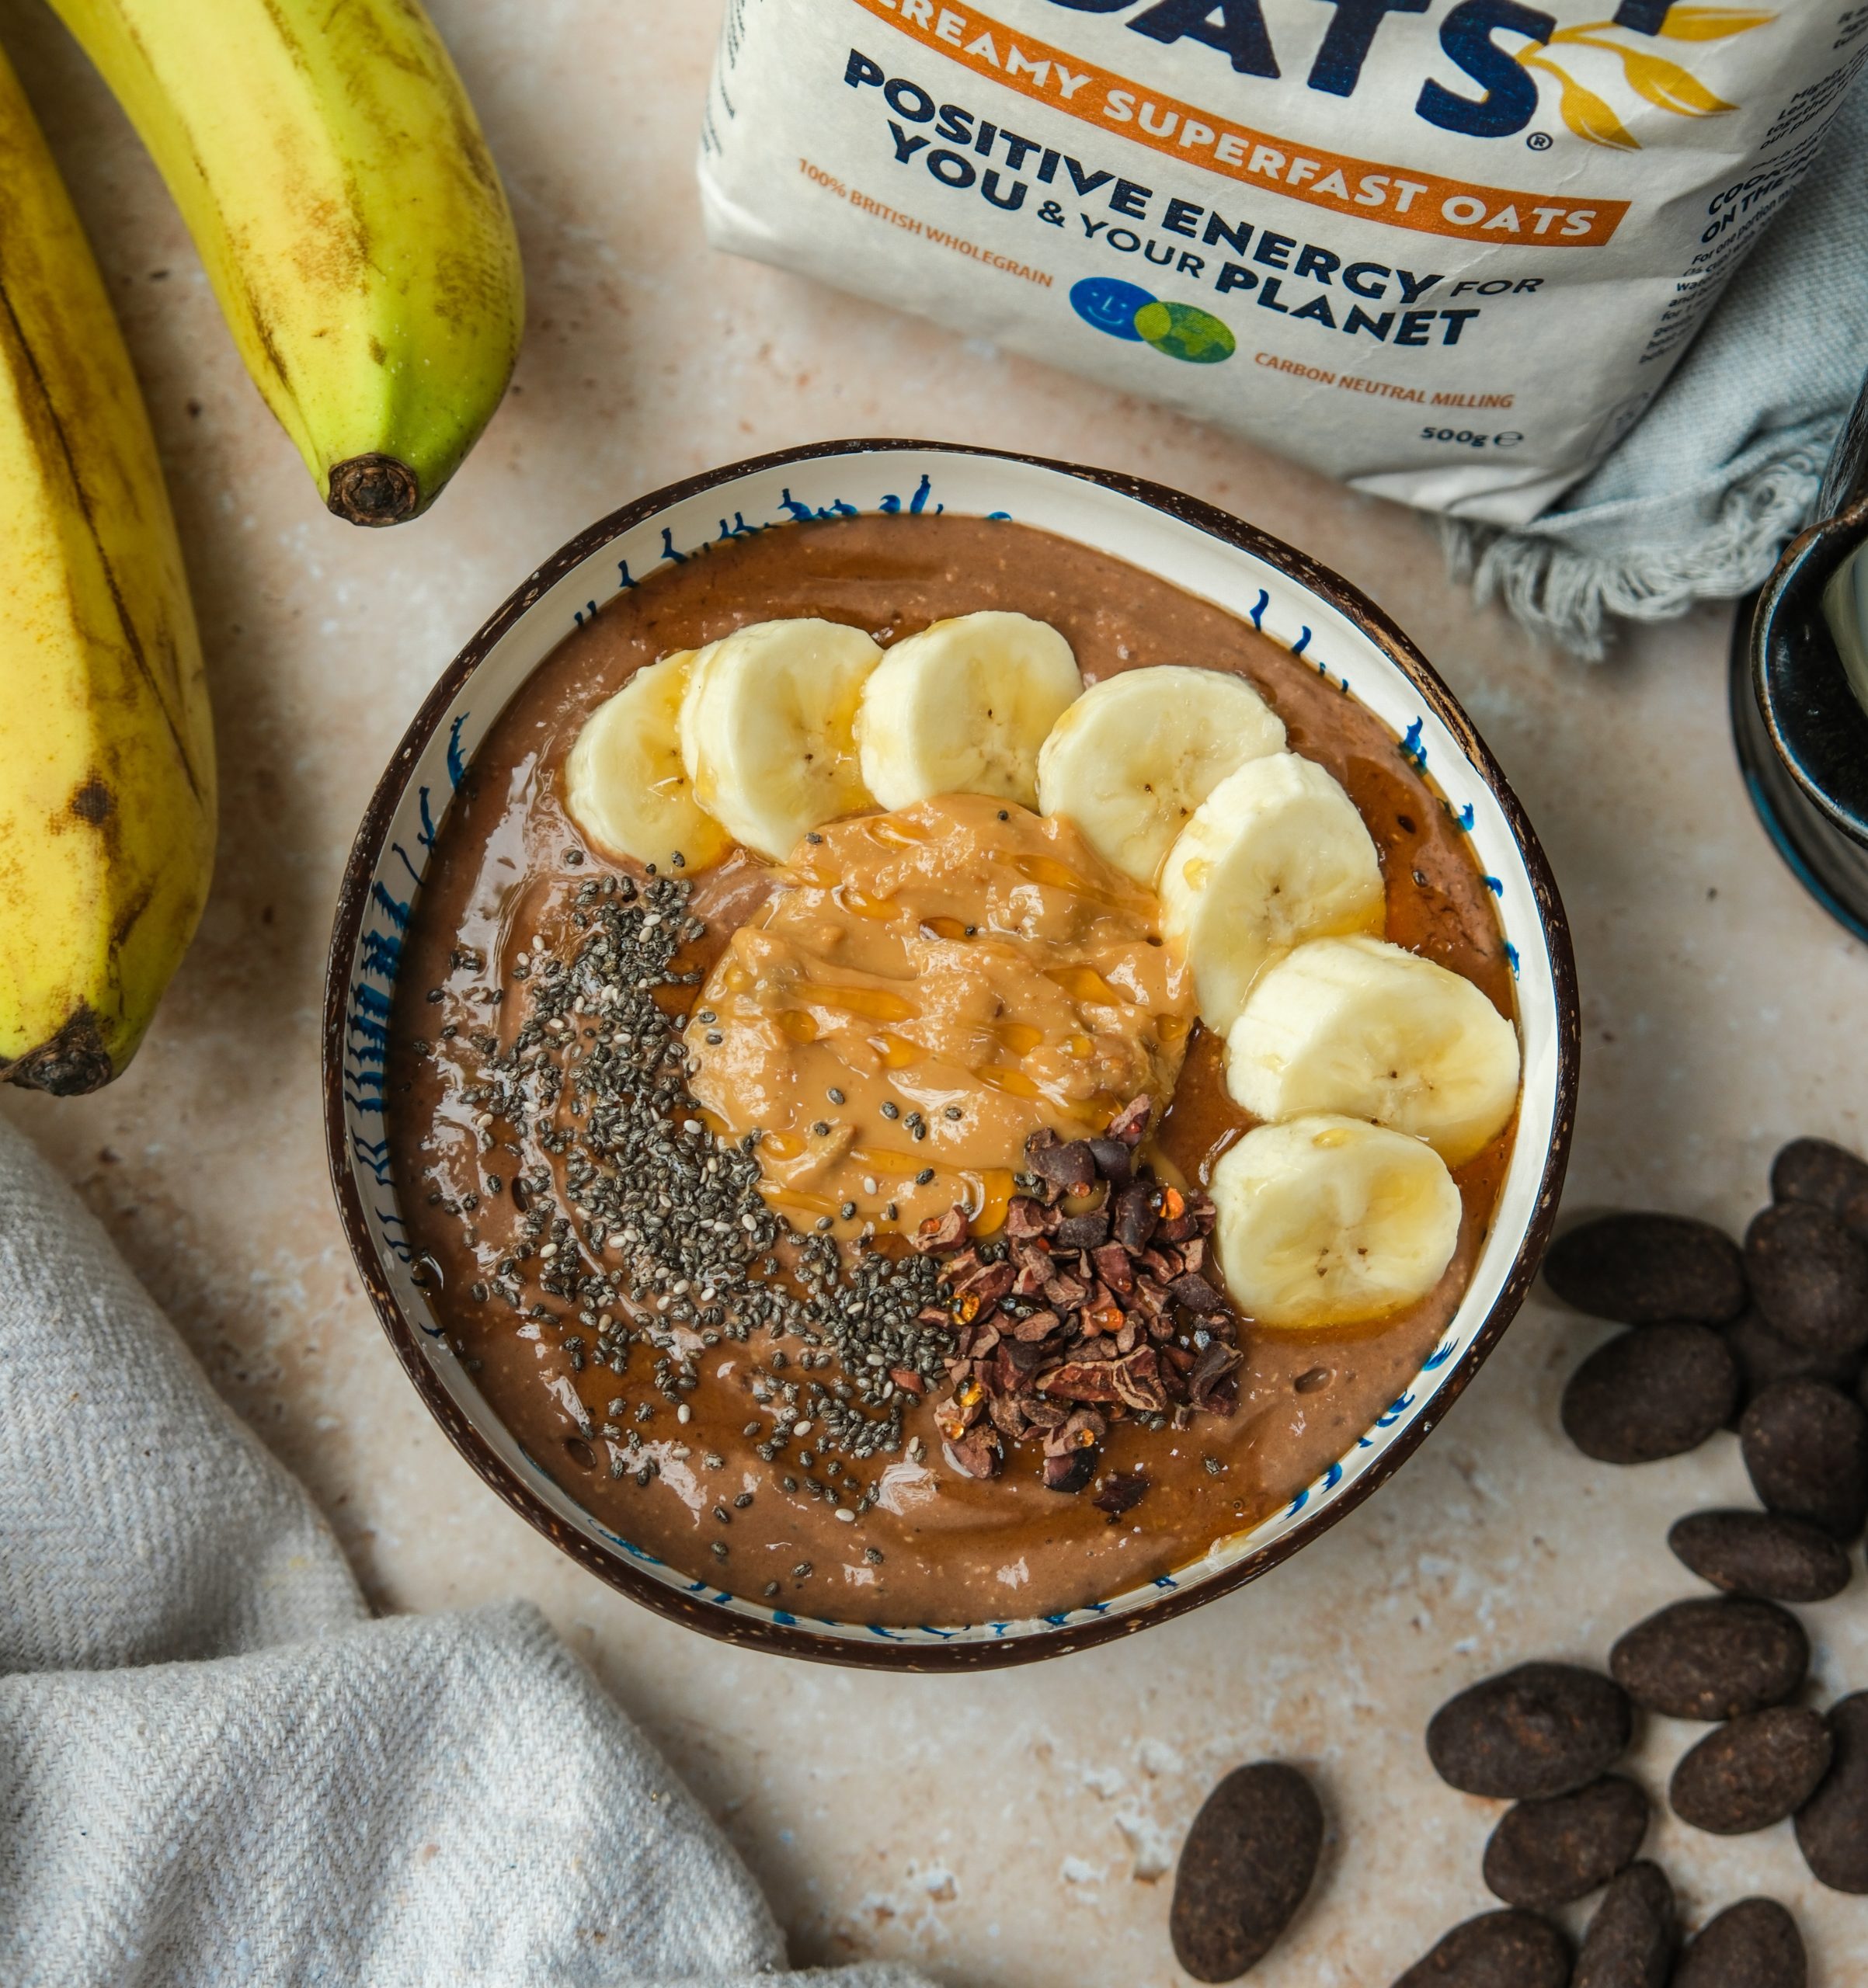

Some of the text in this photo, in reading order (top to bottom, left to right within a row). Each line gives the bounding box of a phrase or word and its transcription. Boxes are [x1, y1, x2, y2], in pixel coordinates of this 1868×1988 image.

[878, 0, 1597, 236] REAMY SUPERFAST OATS
[1045, 0, 1557, 138] ATS
[844, 48, 1153, 220] POSITIVE
[1161, 197, 1445, 304] ENERGY
[1449, 278, 1544, 298] FOR
[1759, 128, 1790, 150] our
[798, 158, 1054, 288] 100% BRITISH WHOLEGRAIN
[887, 119, 1481, 346] YOU & YOUR PLANET
[1692, 248, 1716, 265] For
[1716, 233, 1738, 254] one
[1738, 199, 1776, 239] portion
[1700, 203, 1738, 244] ON
[1741, 172, 1790, 214] THE
[1254, 352, 1515, 409] CARBON NEUTRAL MILLING
[1420, 426, 1488, 447] 500g
